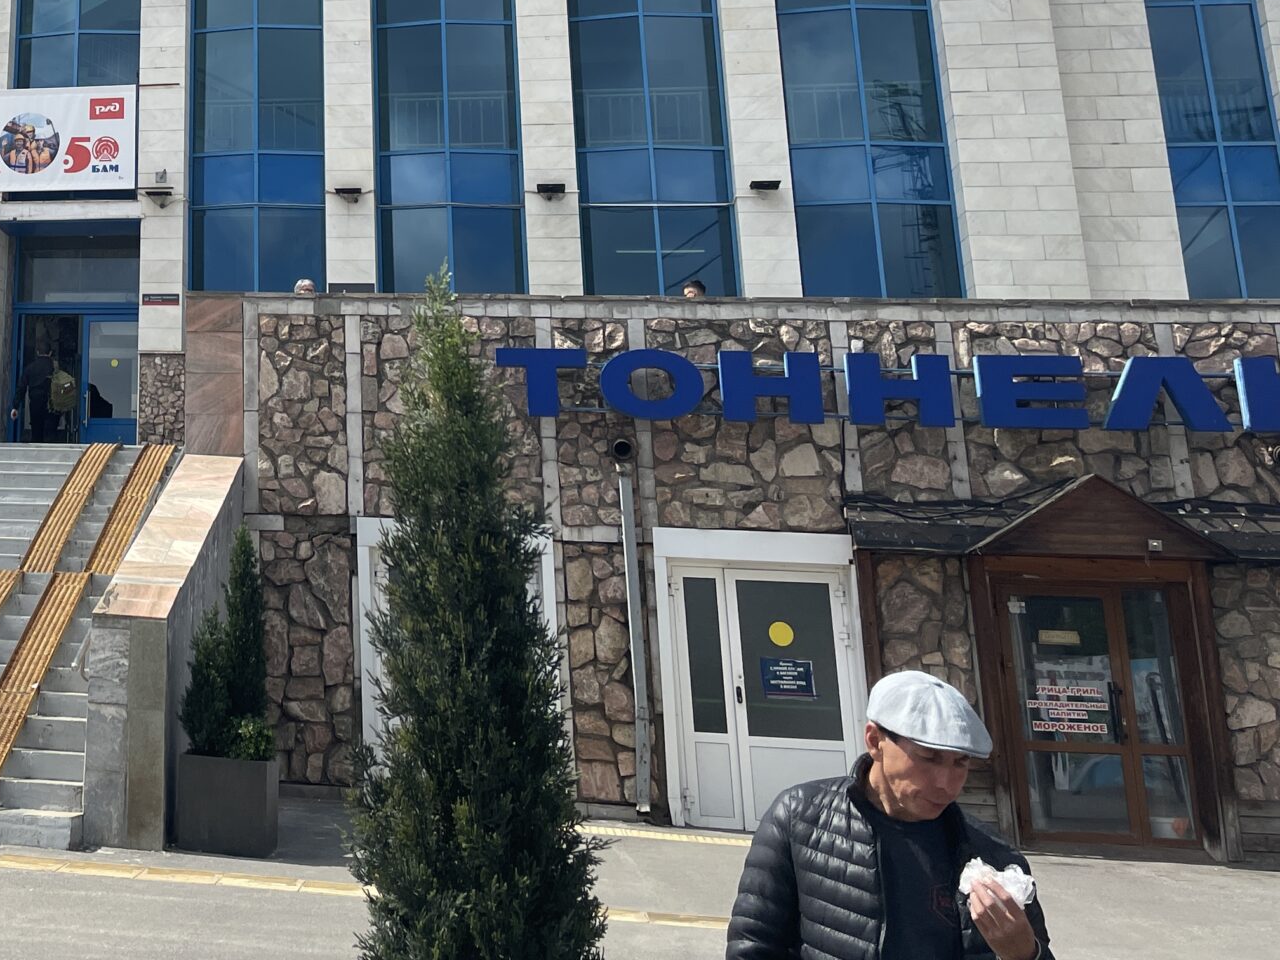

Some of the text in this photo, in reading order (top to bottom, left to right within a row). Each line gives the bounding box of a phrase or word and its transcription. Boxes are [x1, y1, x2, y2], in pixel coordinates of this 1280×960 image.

[91, 164, 119, 173] БАМ
[1027, 701, 1108, 709] ПРОХЛАДИТЕЛЬНЫЕ
[1033, 722, 1107, 733] МОРОЖЕНОЕ
